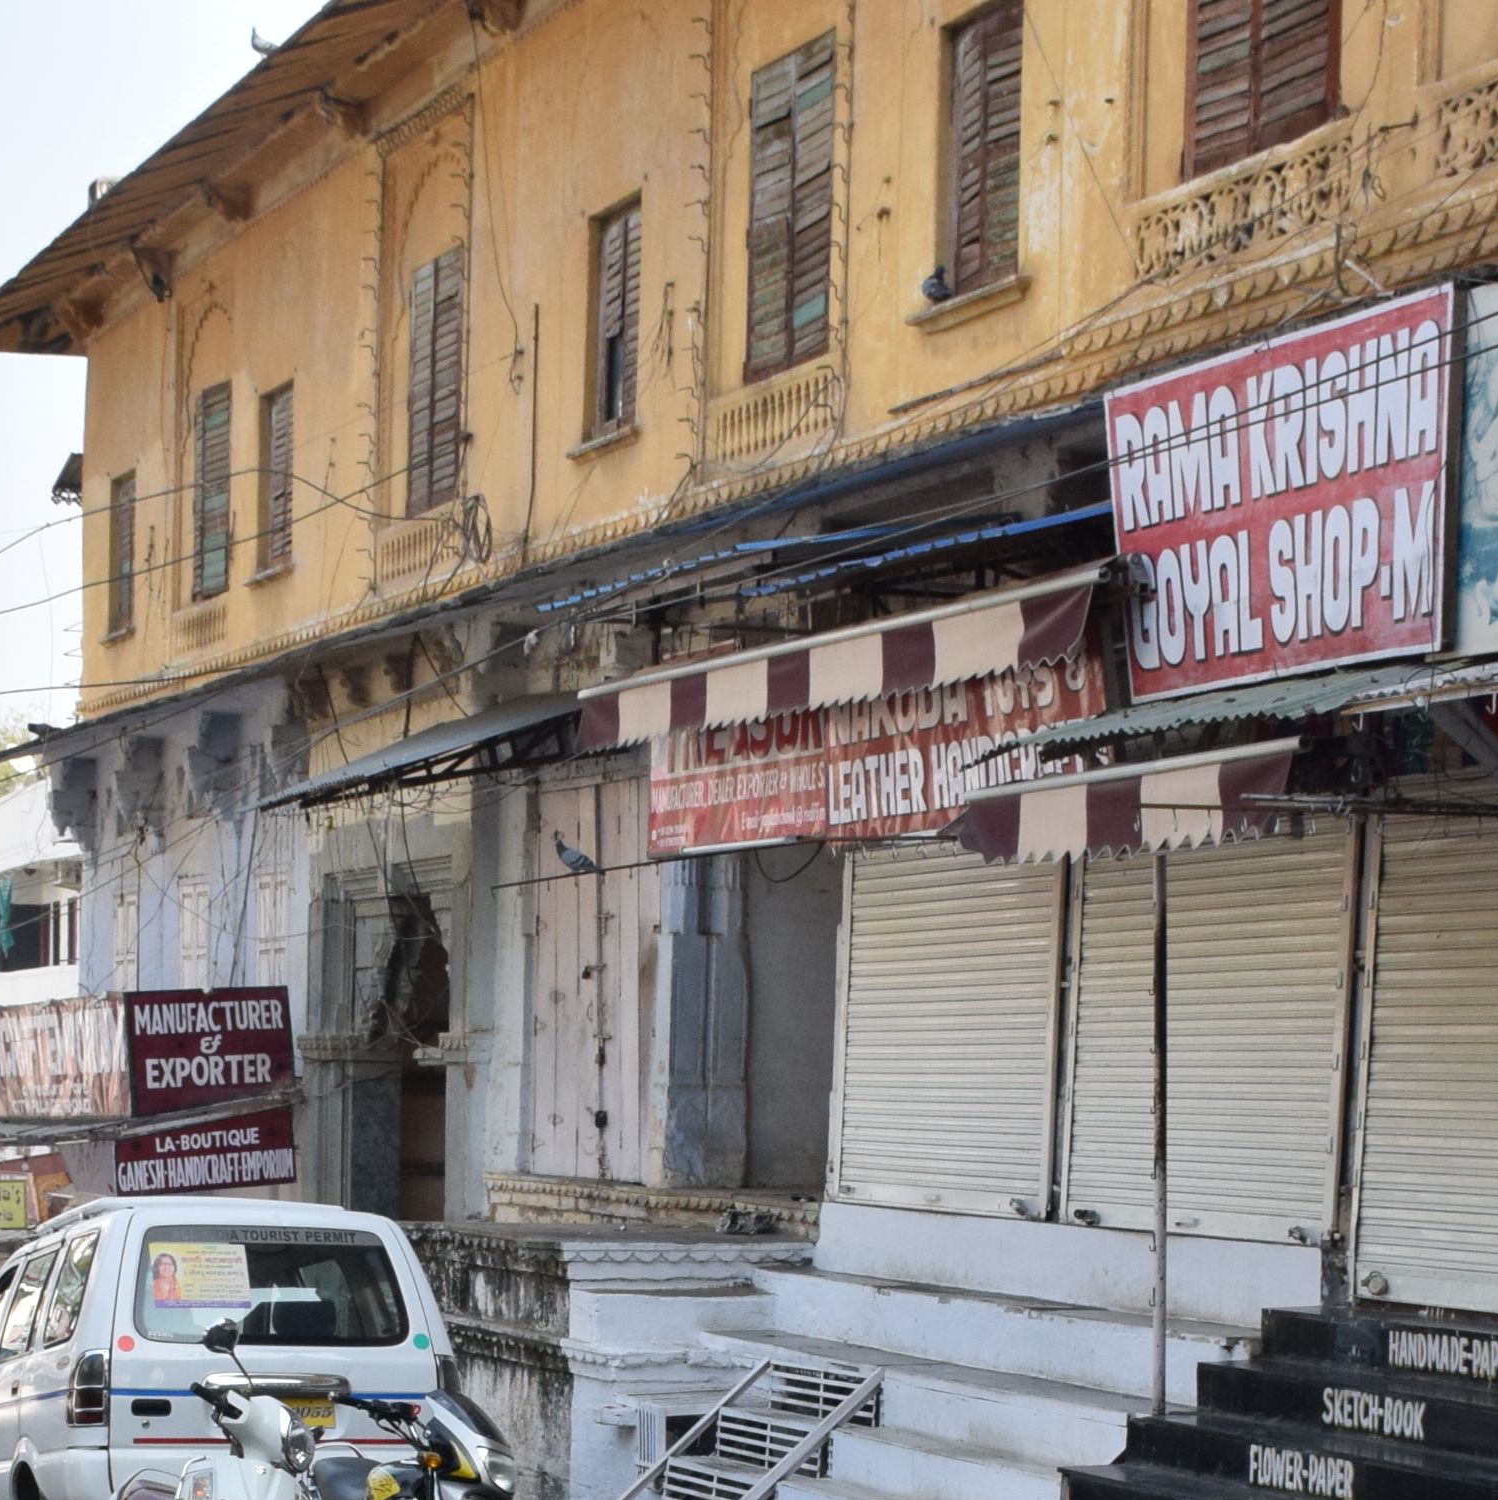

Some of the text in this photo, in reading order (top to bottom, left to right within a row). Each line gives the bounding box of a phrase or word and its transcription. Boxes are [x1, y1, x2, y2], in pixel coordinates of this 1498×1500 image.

[1116, 320, 1441, 531] RAMA KRISHNA
[1131, 530, 1263, 669] GOYAL
[828, 747, 928, 825] LEATHER
[133, 1000, 284, 1035] MANUFACTURER
[146, 1053, 272, 1090] EXPORTER
[156, 1127, 260, 1153] LA-BOUTIQUE
[243, 1229, 300, 1242] TOURIST
[305, 1231, 357, 1244] PERMIT
[1323, 1387, 1426, 1441] SKETCH-BOOK
[1250, 1444, 1354, 1500] FLOWER-PAPER
